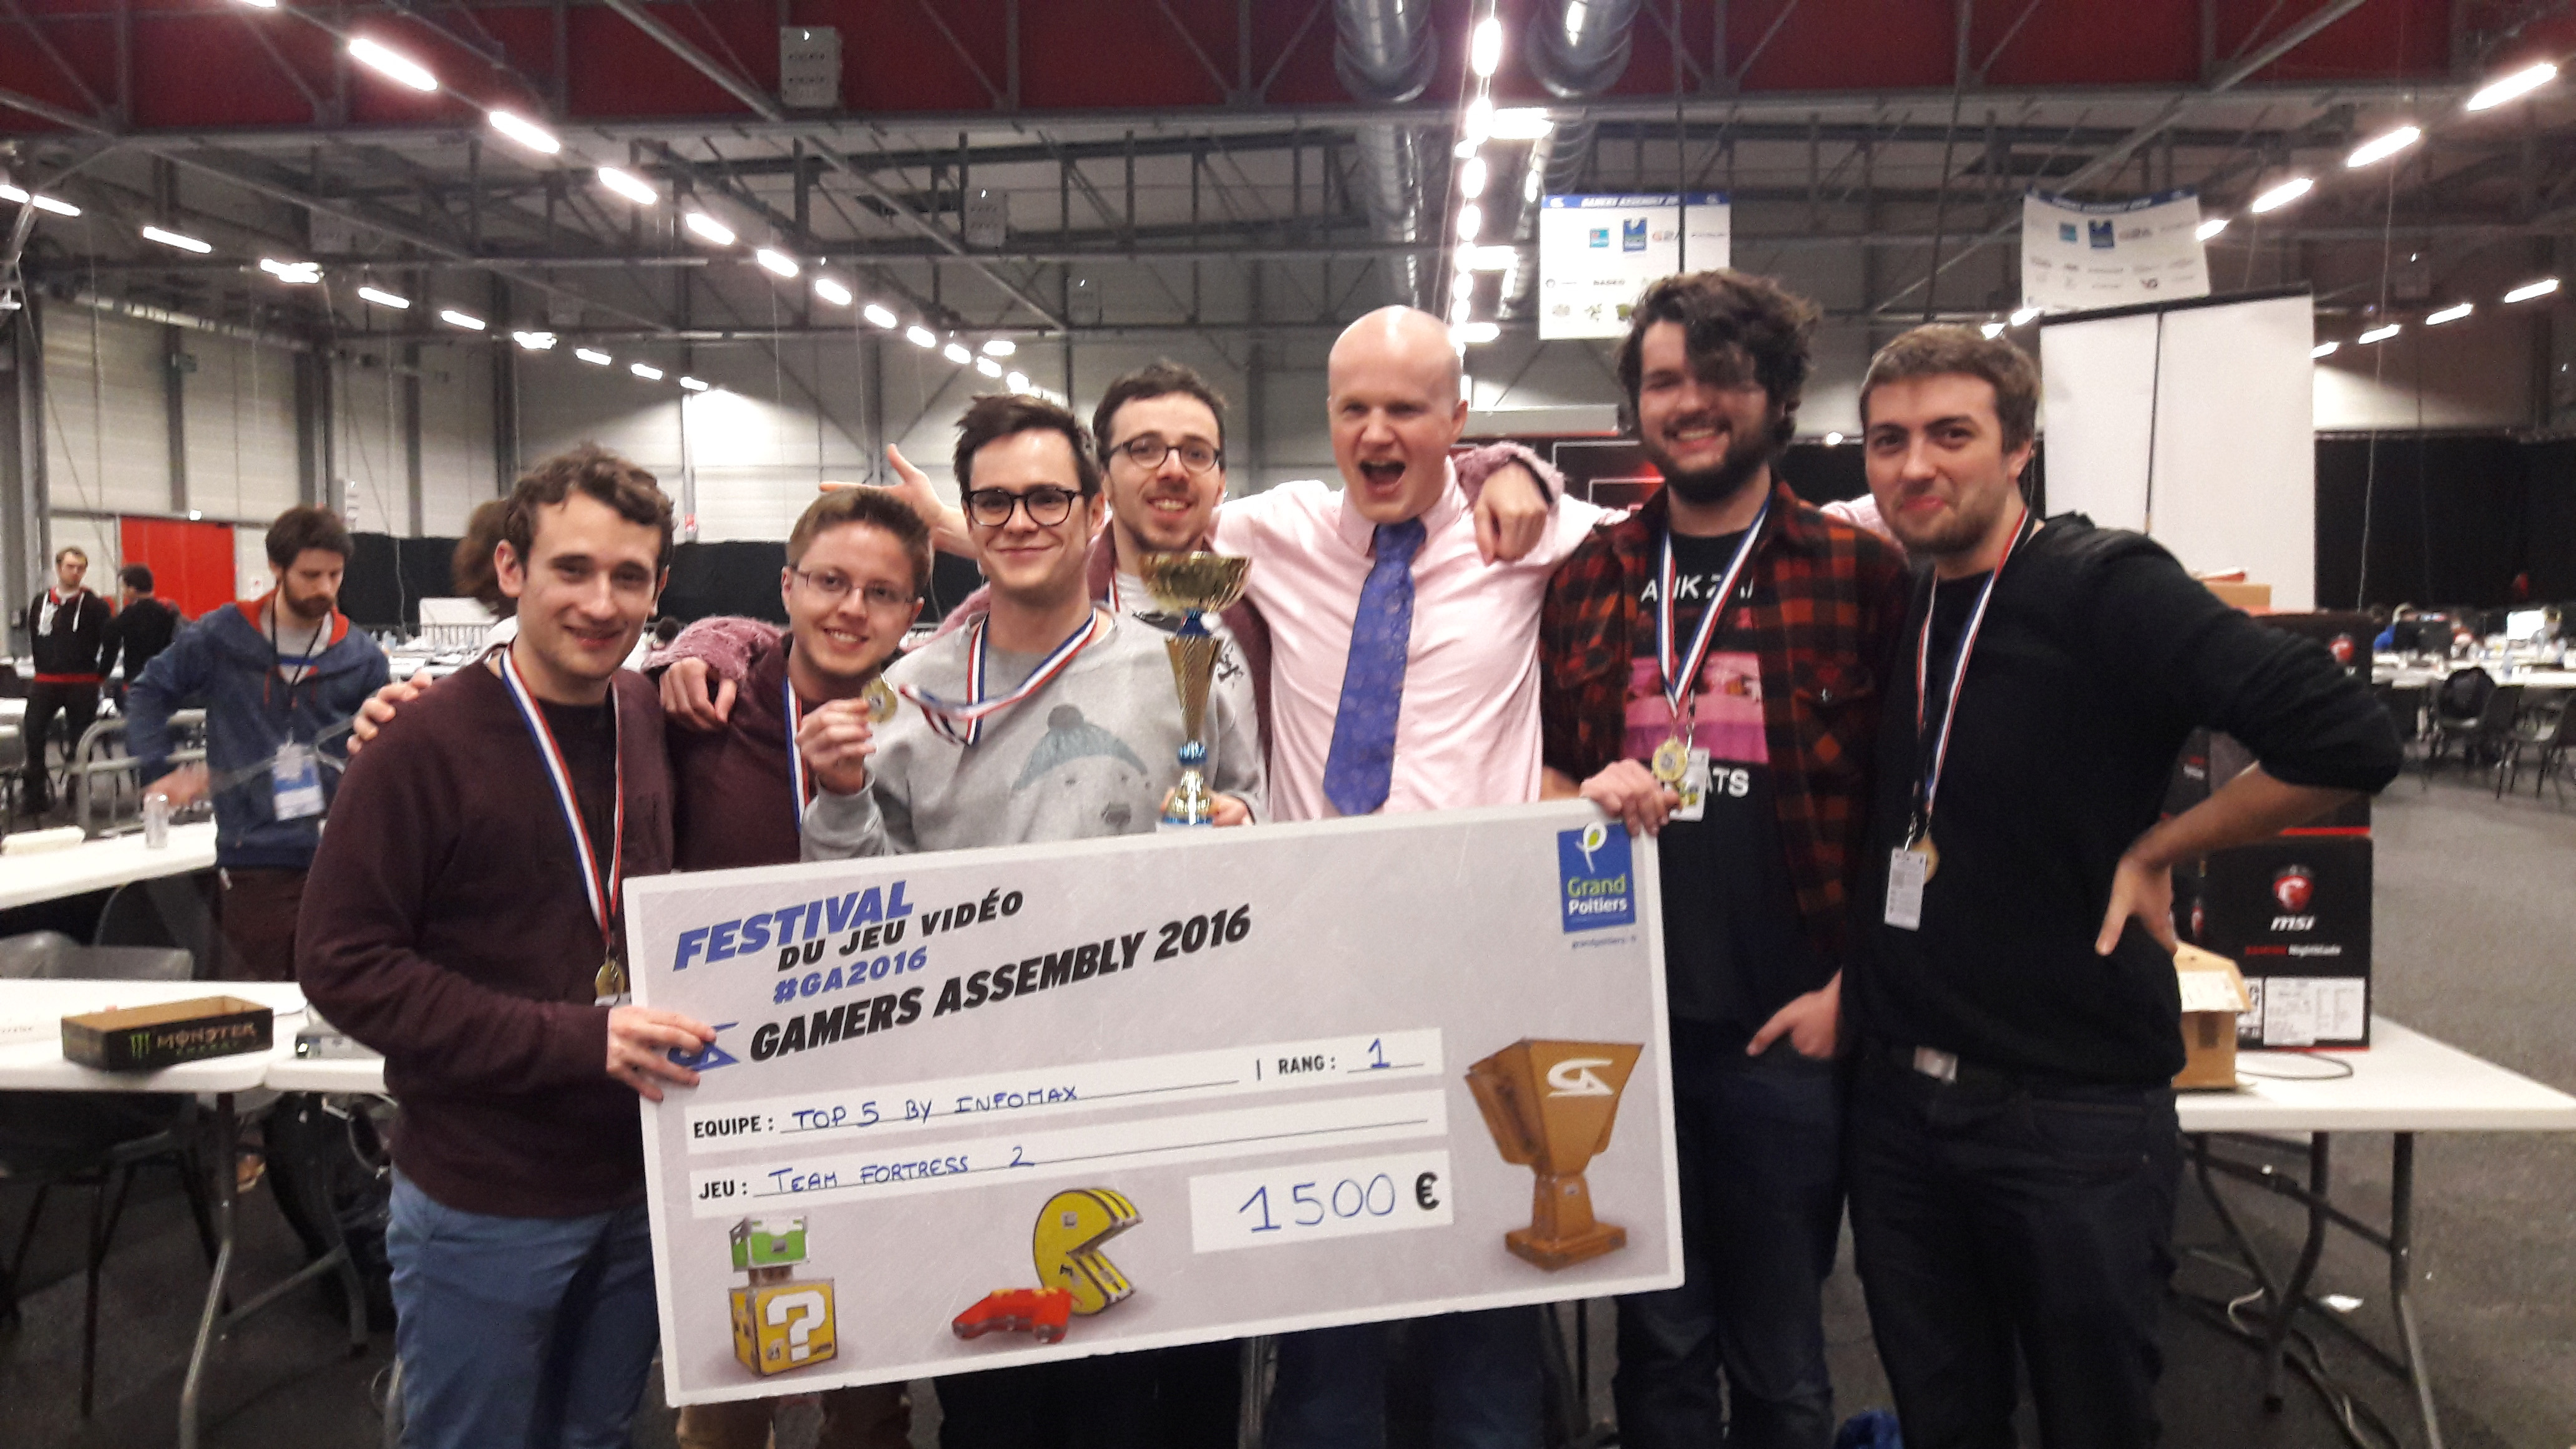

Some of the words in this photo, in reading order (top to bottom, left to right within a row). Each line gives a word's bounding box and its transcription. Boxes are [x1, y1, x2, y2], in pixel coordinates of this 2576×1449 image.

[1568, 874, 1626, 898] Grand
[1568, 897, 1627, 915] Poitiers
[672, 879, 914, 972] FESTIVAL
[778, 939, 826, 972] DU
[838, 919, 906, 957] JEU
[921, 886, 1024, 936] VIDÉO
[750, 986, 925, 1063] GAMERS
[932, 930, 1148, 1018] ASSEMBLY
[1153, 902, 1250, 963] 2016
[773, 945, 928, 1005] #GA2016
[1368, 1038, 1391, 1069] 1
[791, 1106, 847, 1131] TOP
[855, 1101, 880, 1128] 5
[905, 1098, 932, 1123] BY
[954, 1085, 1078, 1115] INFOMAX
[768, 1167, 838, 1196] TEAM
[860, 1155, 968, 1184] FORTRESS
[1009, 1146, 1035, 1168] 2
[1415, 1171, 1441, 1211] €
[1239, 1173, 1396, 1233] 1500
